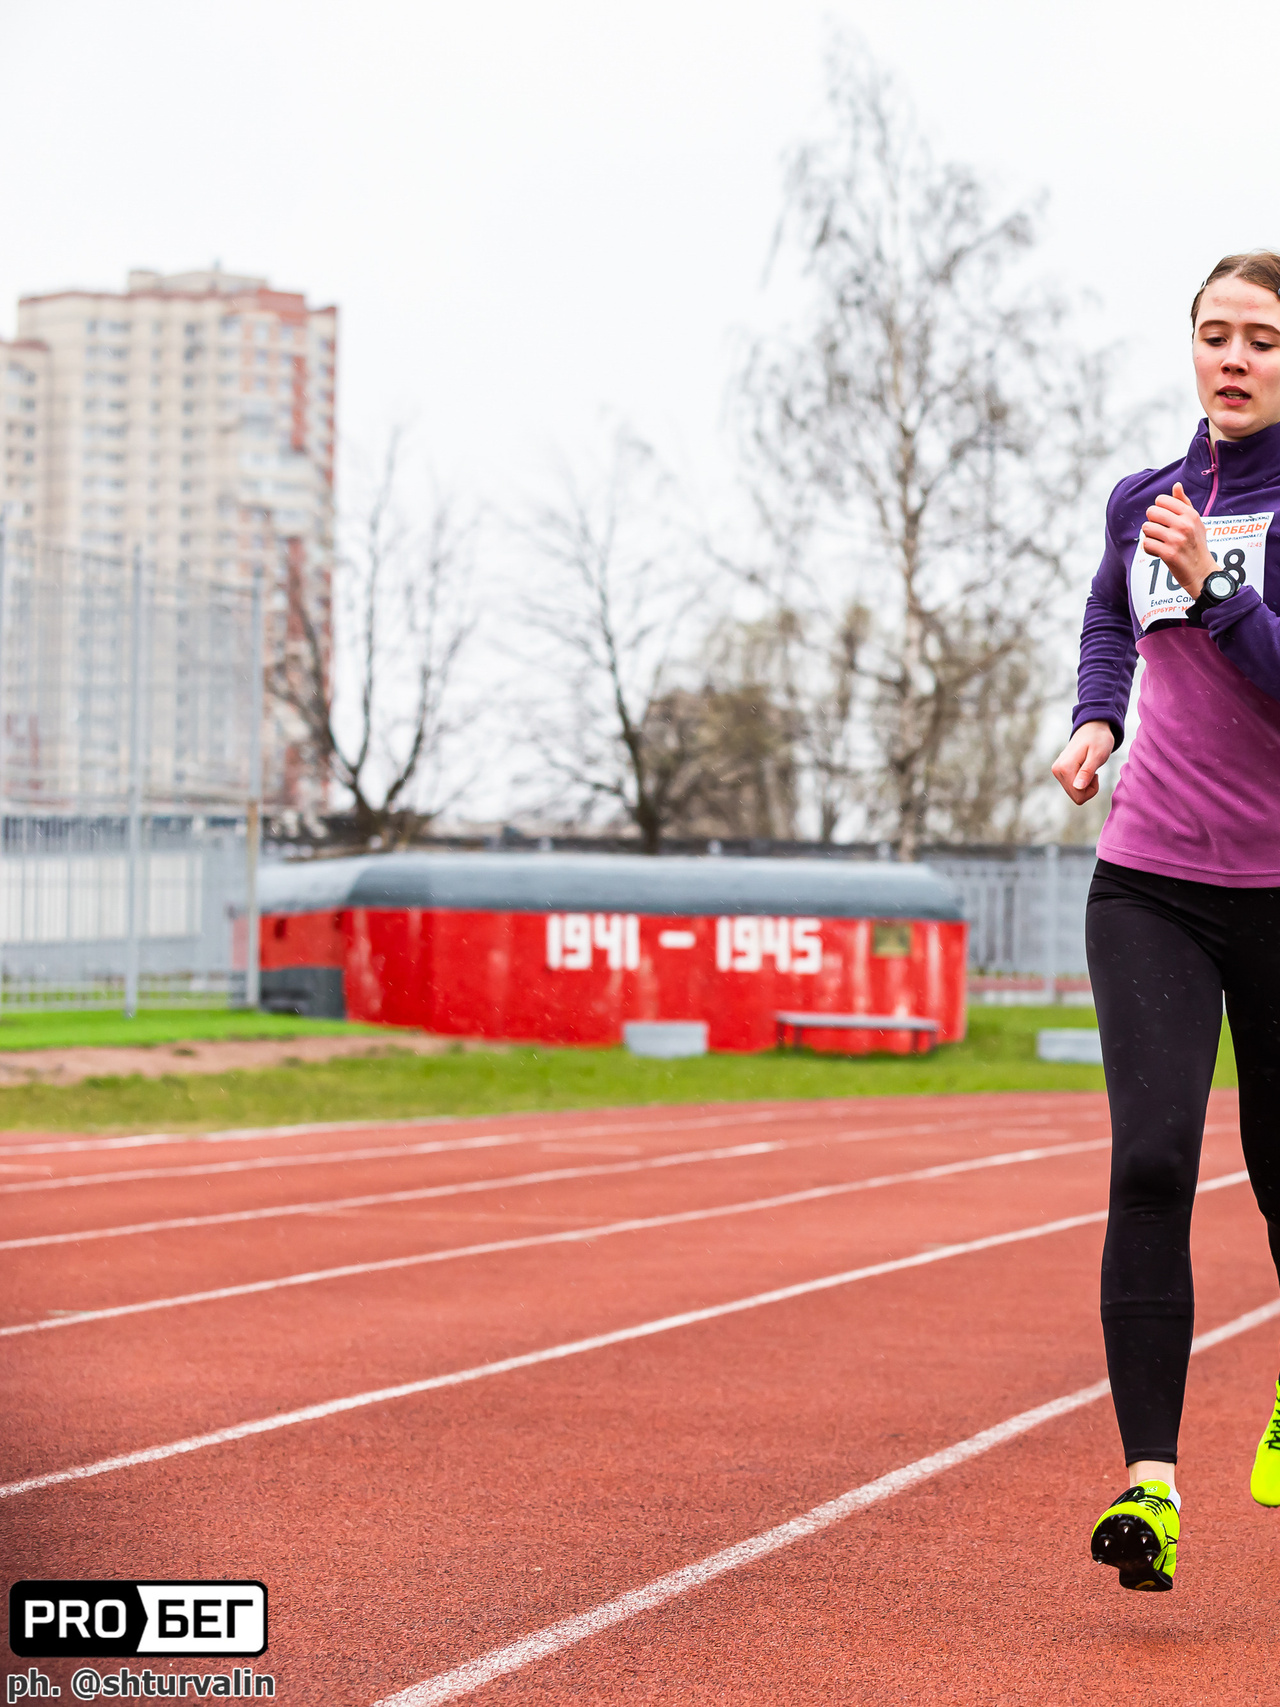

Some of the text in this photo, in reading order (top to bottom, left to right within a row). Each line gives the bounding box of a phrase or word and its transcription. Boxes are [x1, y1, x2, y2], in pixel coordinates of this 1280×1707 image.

[1212, 522, 1267, 536] ПОБЕДЫ
[1150, 597, 1173, 607] Елена
[546, 913, 640, 971] 1941
[716, 916, 822, 974] 1945
